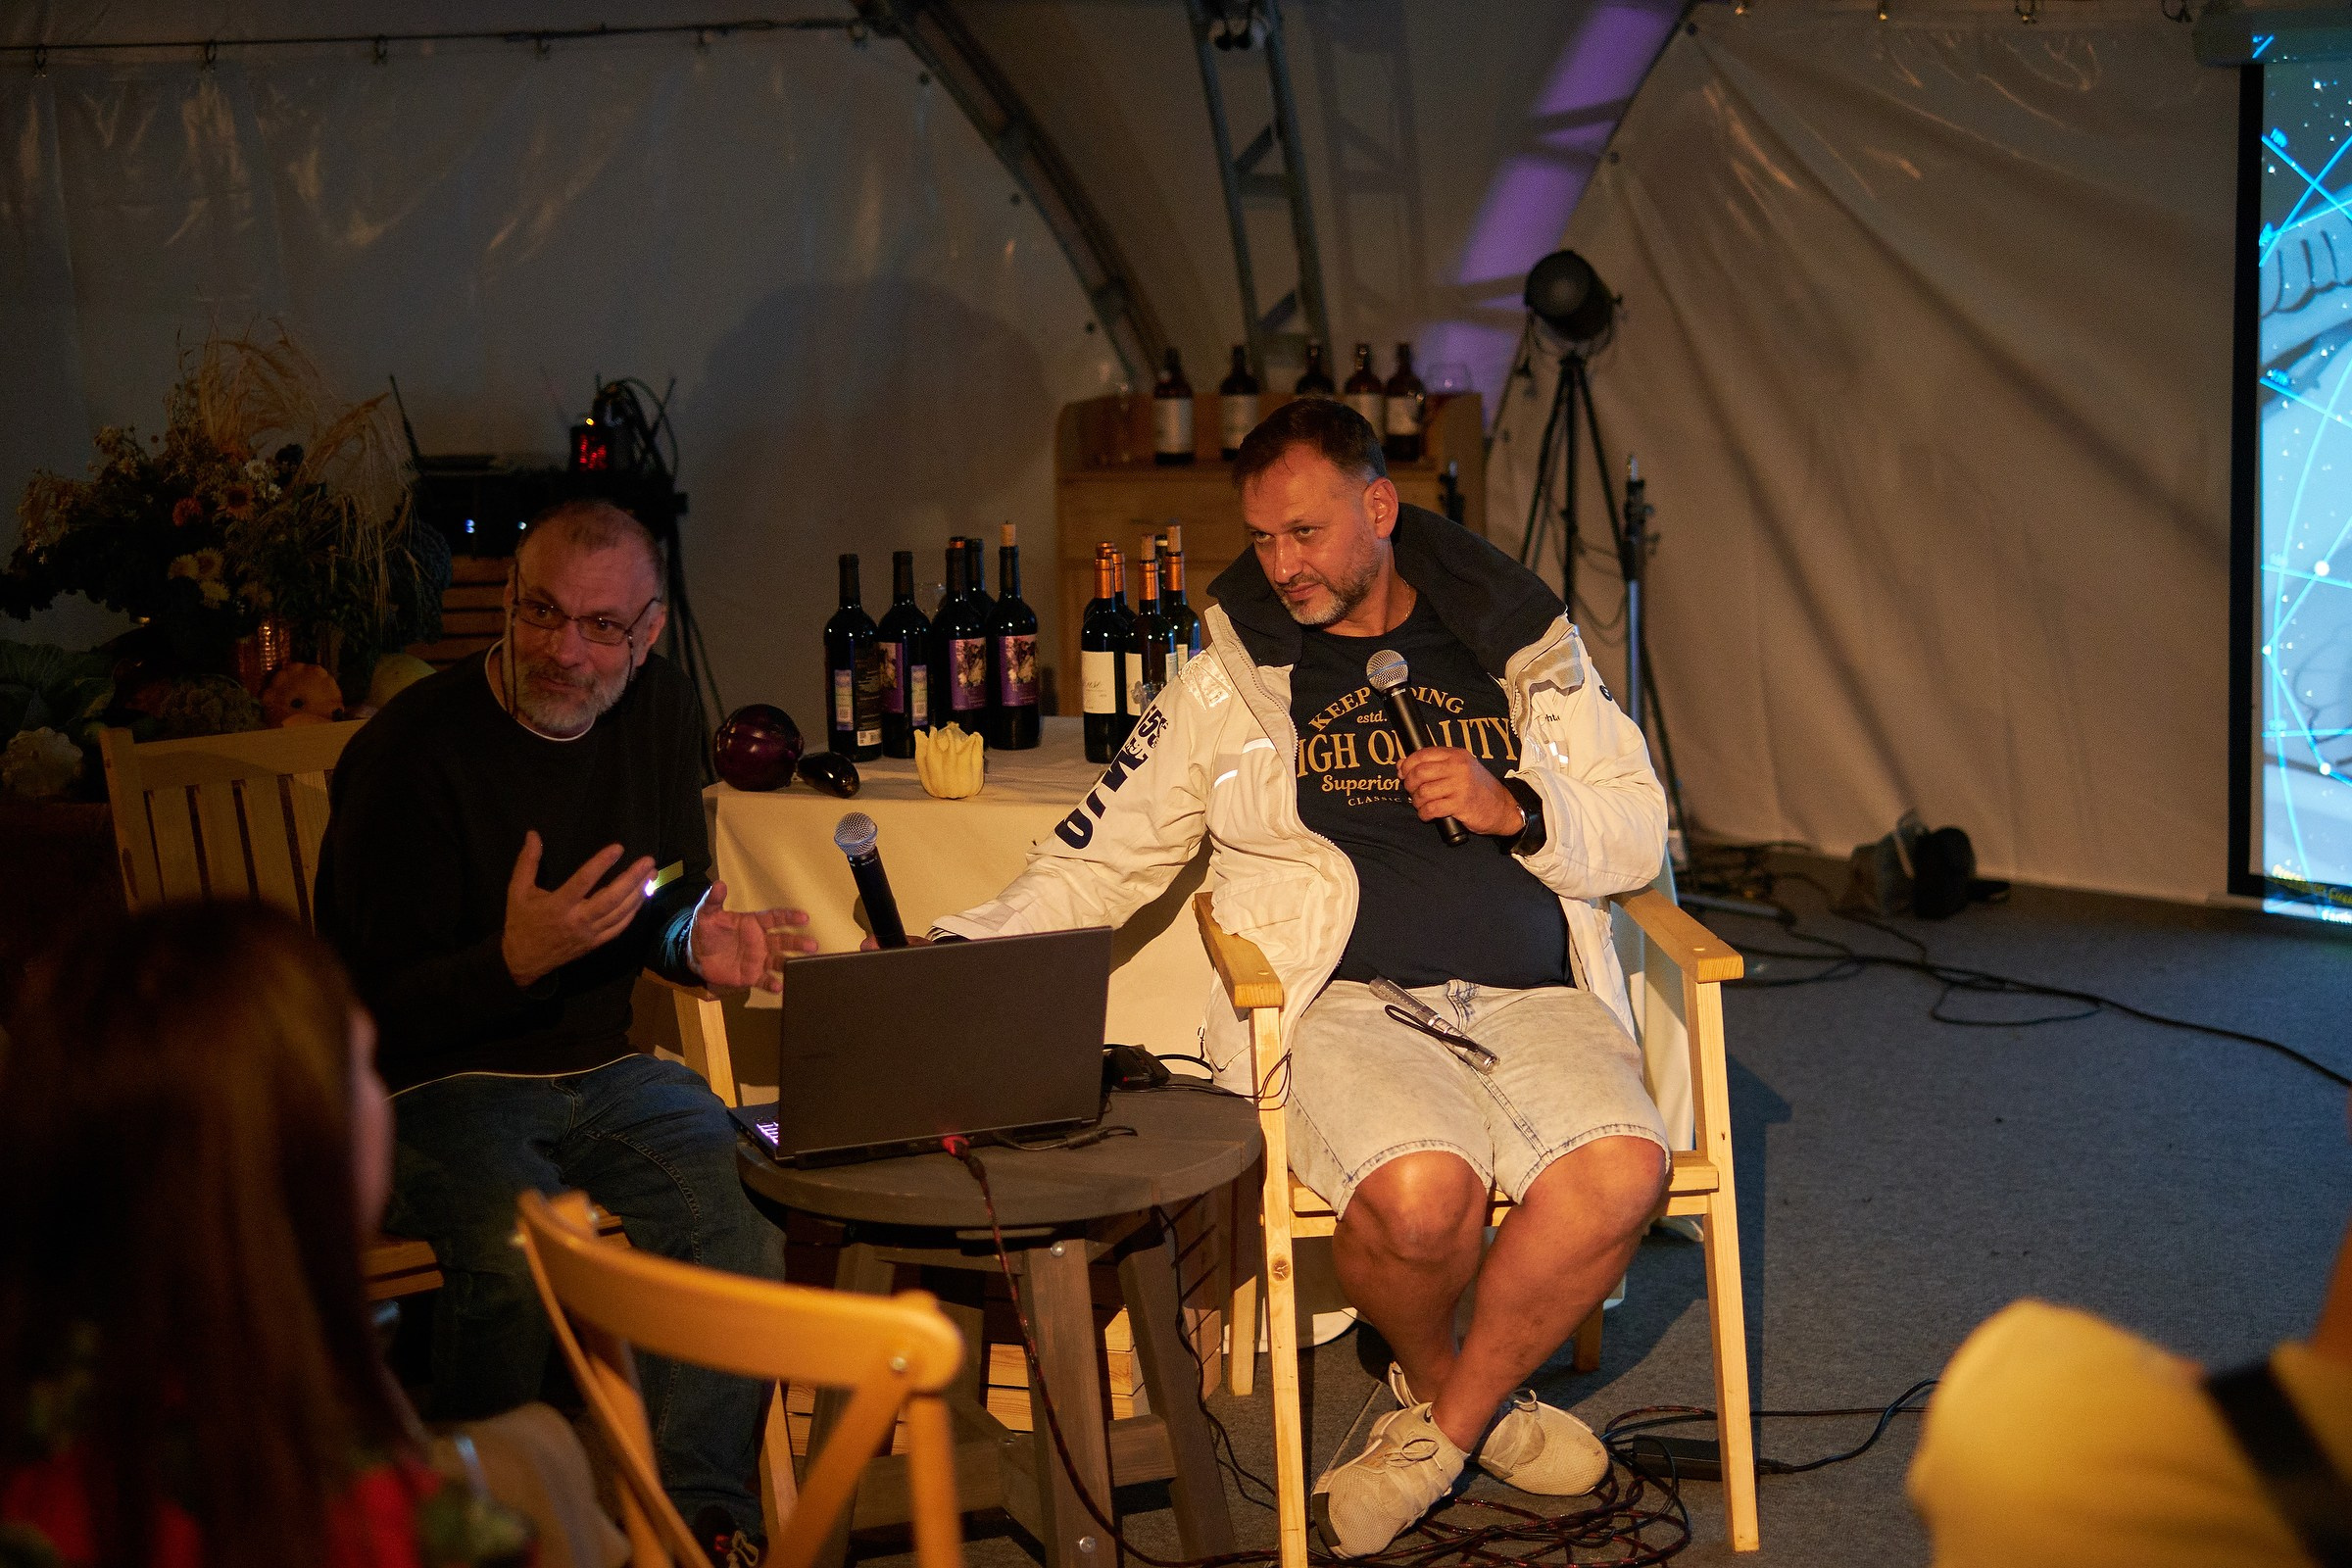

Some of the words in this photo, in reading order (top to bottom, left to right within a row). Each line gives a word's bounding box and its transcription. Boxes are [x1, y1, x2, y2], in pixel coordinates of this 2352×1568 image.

[1308, 686, 1371, 732] KEEP
[1356, 710, 1389, 724] estd.
[1296, 733, 1361, 778] IGH
